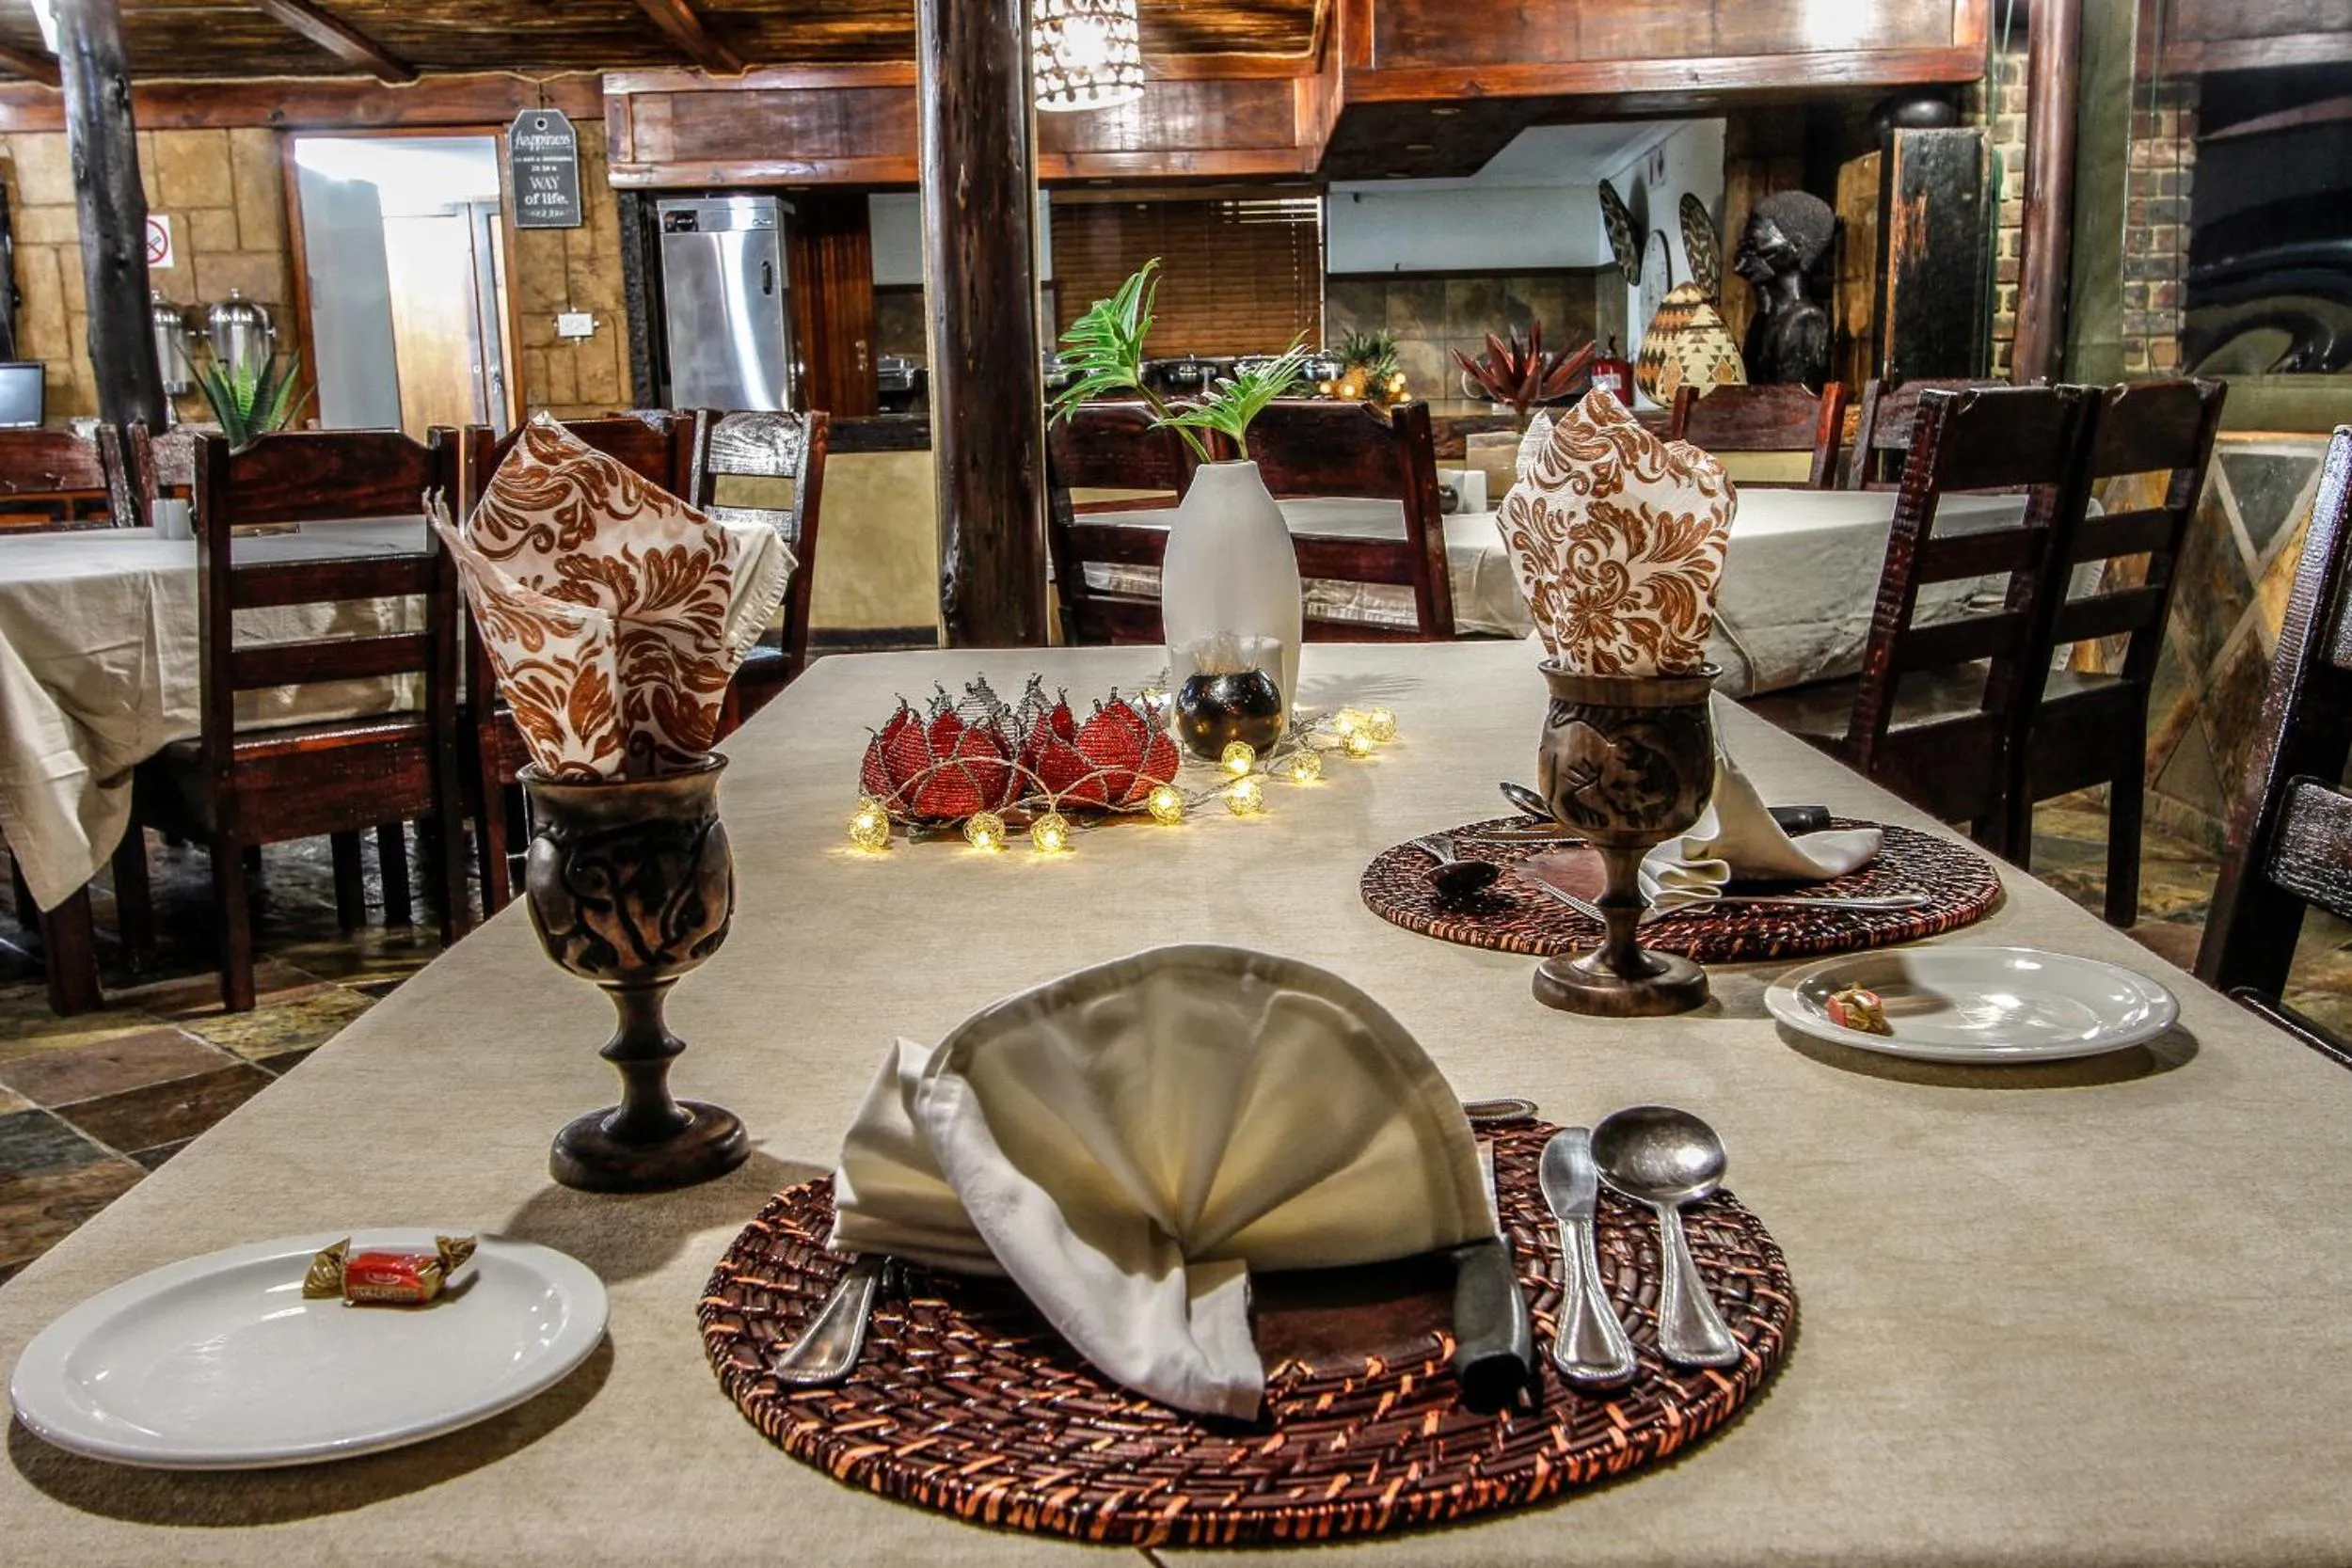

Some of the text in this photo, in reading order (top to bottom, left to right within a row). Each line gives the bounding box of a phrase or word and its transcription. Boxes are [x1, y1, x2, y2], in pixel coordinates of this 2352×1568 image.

[529, 176, 560, 190] WAY
[525, 192, 569, 205] of life.
